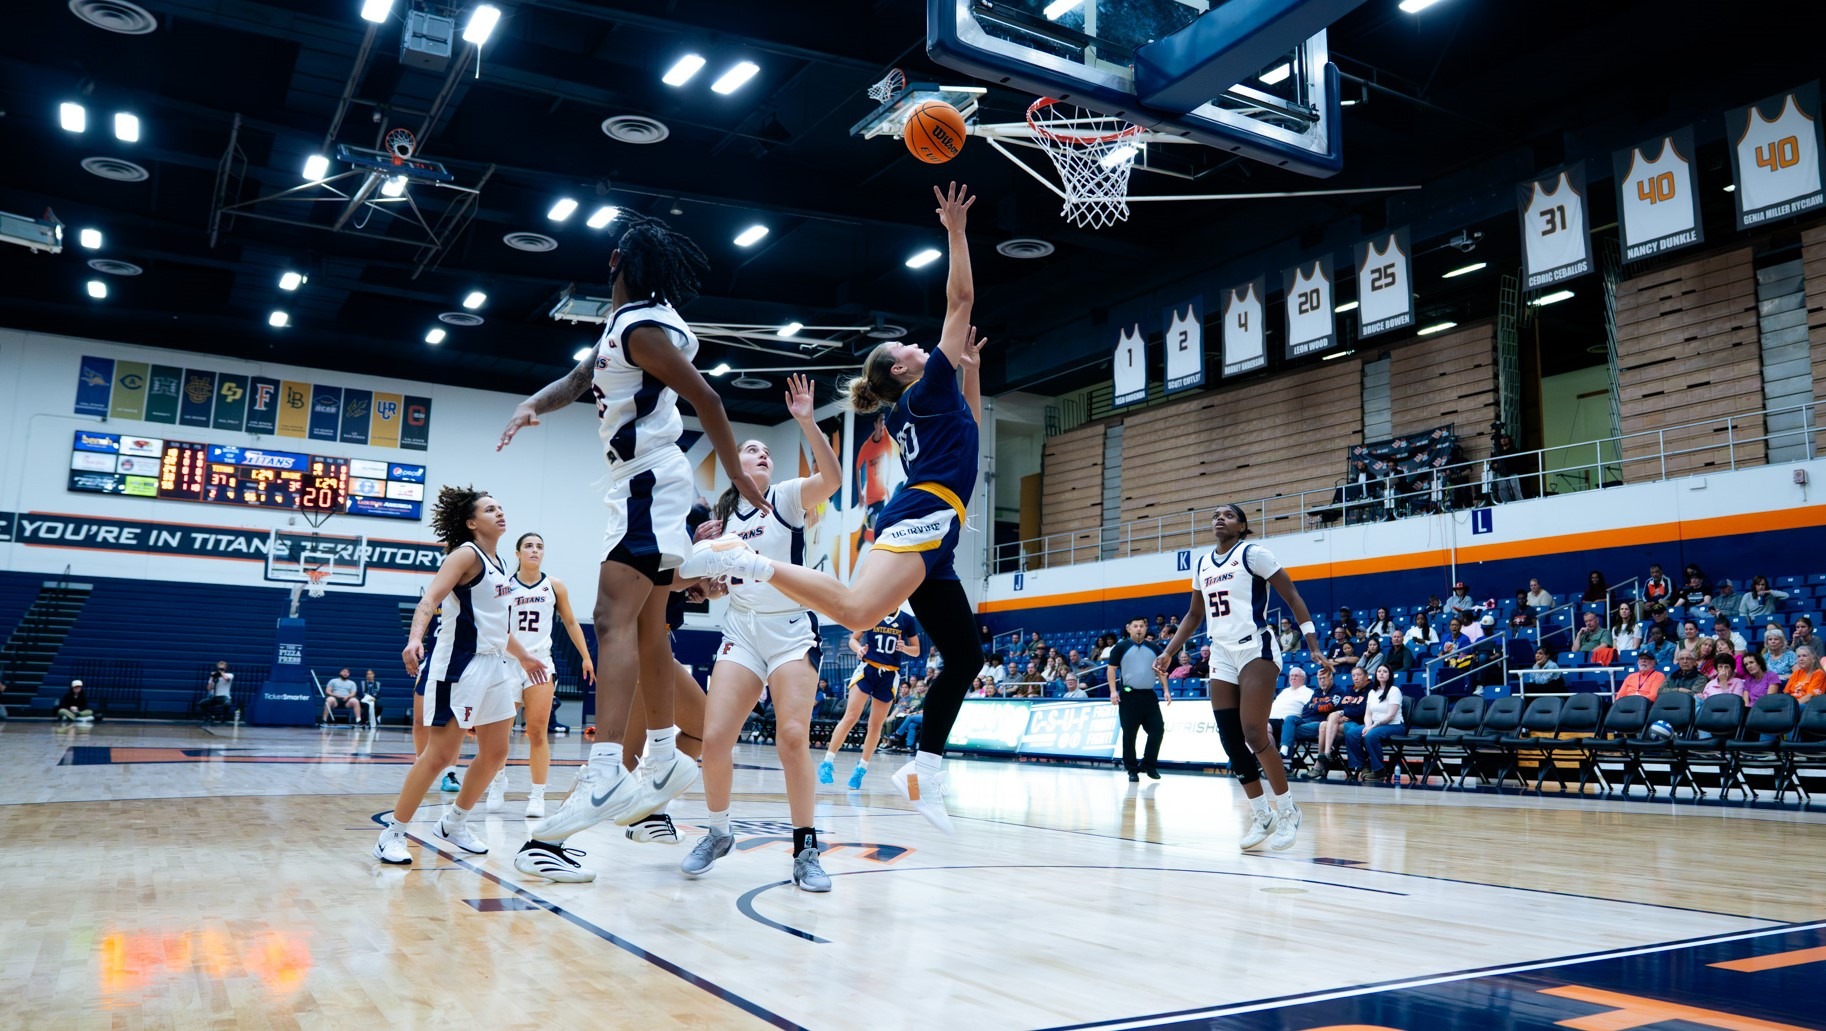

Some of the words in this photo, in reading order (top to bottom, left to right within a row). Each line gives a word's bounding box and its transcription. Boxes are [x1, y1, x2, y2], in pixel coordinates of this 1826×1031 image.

[932, 125, 959, 155] Wilson
[1755, 135, 1800, 172] 40
[1637, 171, 1676, 205] 40
[1539, 204, 1567, 236] 31
[1743, 212, 1765, 225] GENIA
[1766, 205, 1791, 219] MILLER
[1792, 194, 1824, 212] RYCRAW
[1627, 241, 1658, 259] NANCY
[1660, 230, 1697, 250] DUNKLE
[1370, 263, 1397, 292] 25
[1528, 272, 1554, 287] CEDRIC
[1554, 261, 1588, 281] CEBALLOS
[1298, 287, 1321, 315] 20
[1238, 311, 1248, 332] 4
[1362, 322, 1385, 335] BRUCE
[1385, 314, 1410, 330] BOWEN
[1178, 330, 1188, 352] 2
[1293, 343, 1308, 355] LEON
[1309, 337, 1328, 351] WOOD
[1127, 348, 1132, 367] 1
[252, 383, 275, 411] F
[241, 450, 296, 468] TITANS
[211, 474, 227, 485] 37
[303, 487, 333, 508] 20
[892, 527, 906, 539] UC
[908, 521, 941, 536] IRVINE
[1478, 511, 1488, 533] L
[21, 519, 141, 545] YOU'RE
[148, 530, 188, 548] IN
[190, 533, 292, 556] TITANS
[300, 541, 450, 567] TERRITORY
[1179, 551, 1188, 569] K
[1016, 574, 1022, 590] J
[1203, 571, 1236, 590] TITANS
[514, 595, 546, 607] TITANS
[1208, 590, 1231, 618] 55
[518, 610, 540, 633] 22
[722, 643, 735, 655] F
[875, 634, 897, 655] 10
[264, 692, 310, 701] TicketSmarter
[464, 706, 473, 722] F
[1030, 706, 1092, 734] C-S-U-F
[1164, 721, 1220, 733] UTRISH
